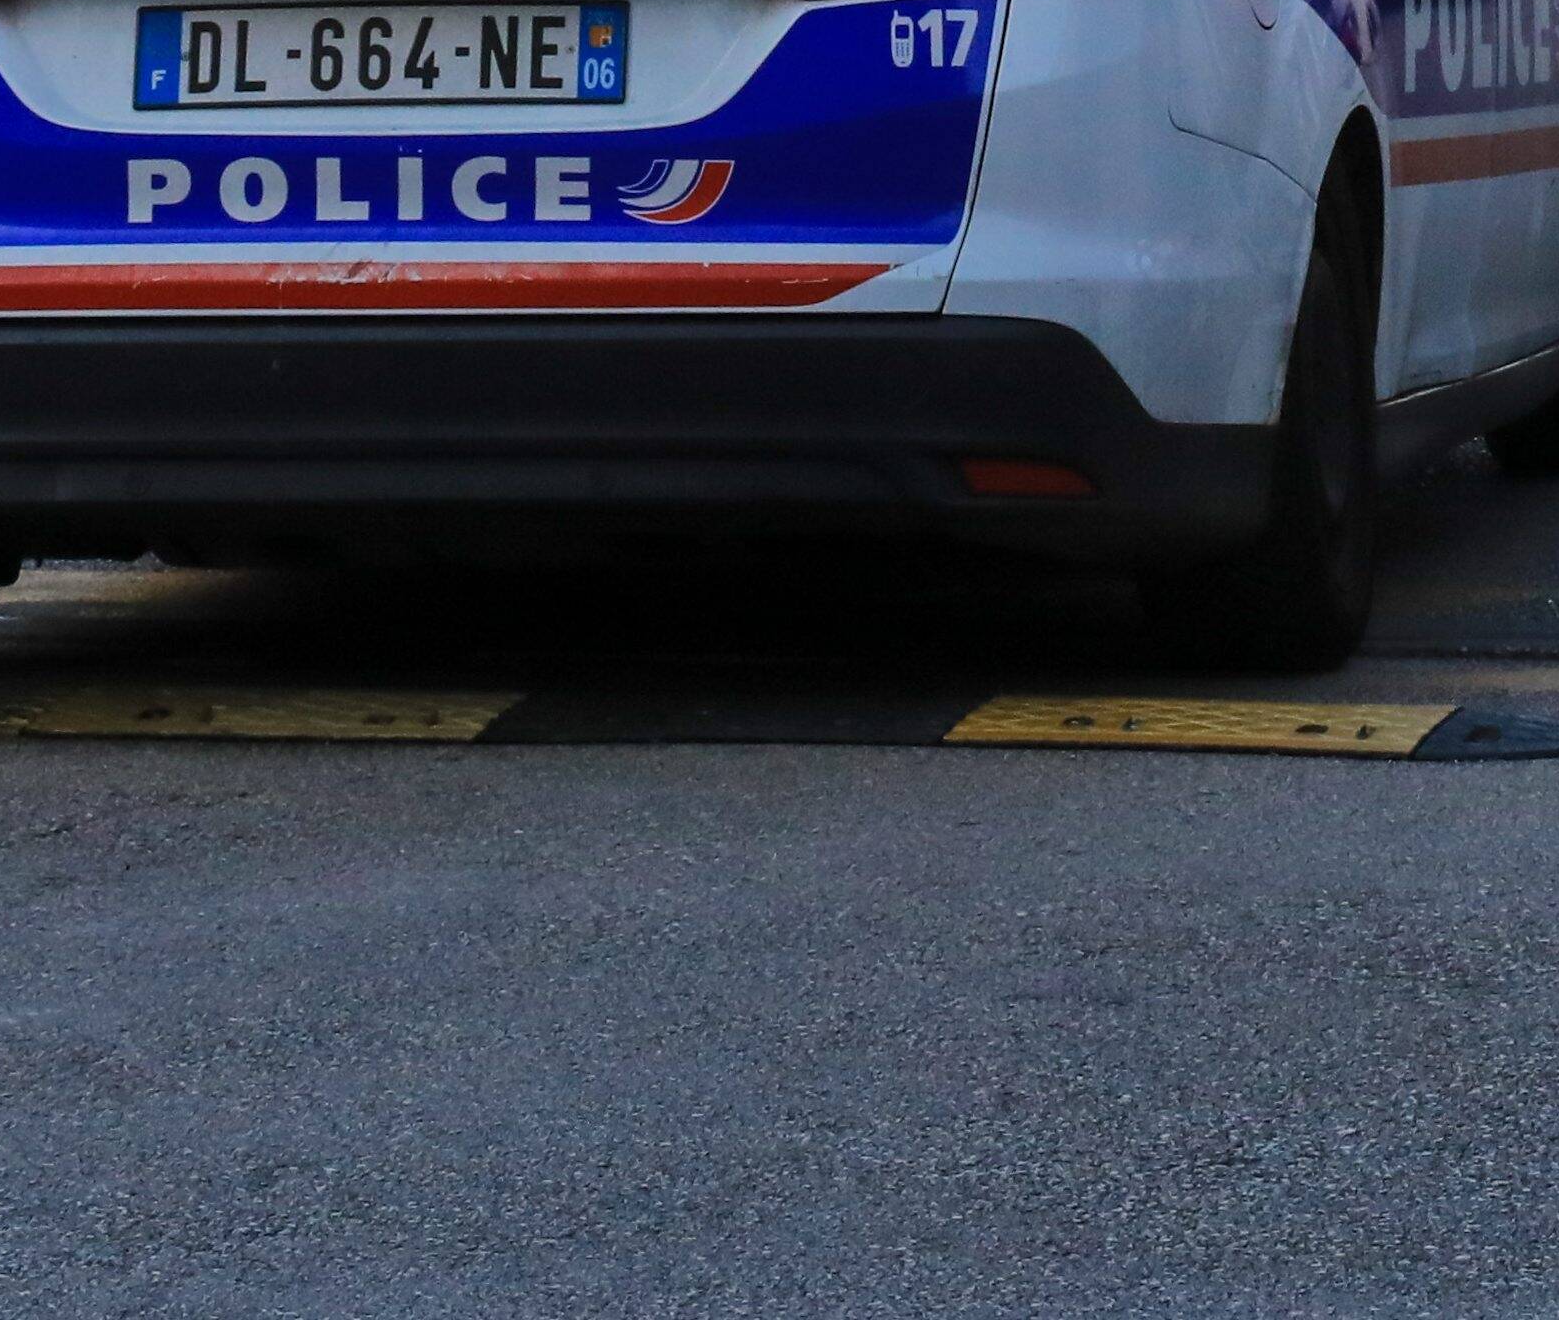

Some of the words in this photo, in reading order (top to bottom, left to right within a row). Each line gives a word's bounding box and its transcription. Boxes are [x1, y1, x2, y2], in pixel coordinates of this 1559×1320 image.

[151, 69, 167, 91] F
[187, 15, 567, 95] DL-664-NE
[583, 57, 616, 90] 06
[917, 8, 979, 67] 17
[127, 155, 592, 224] POLICE
